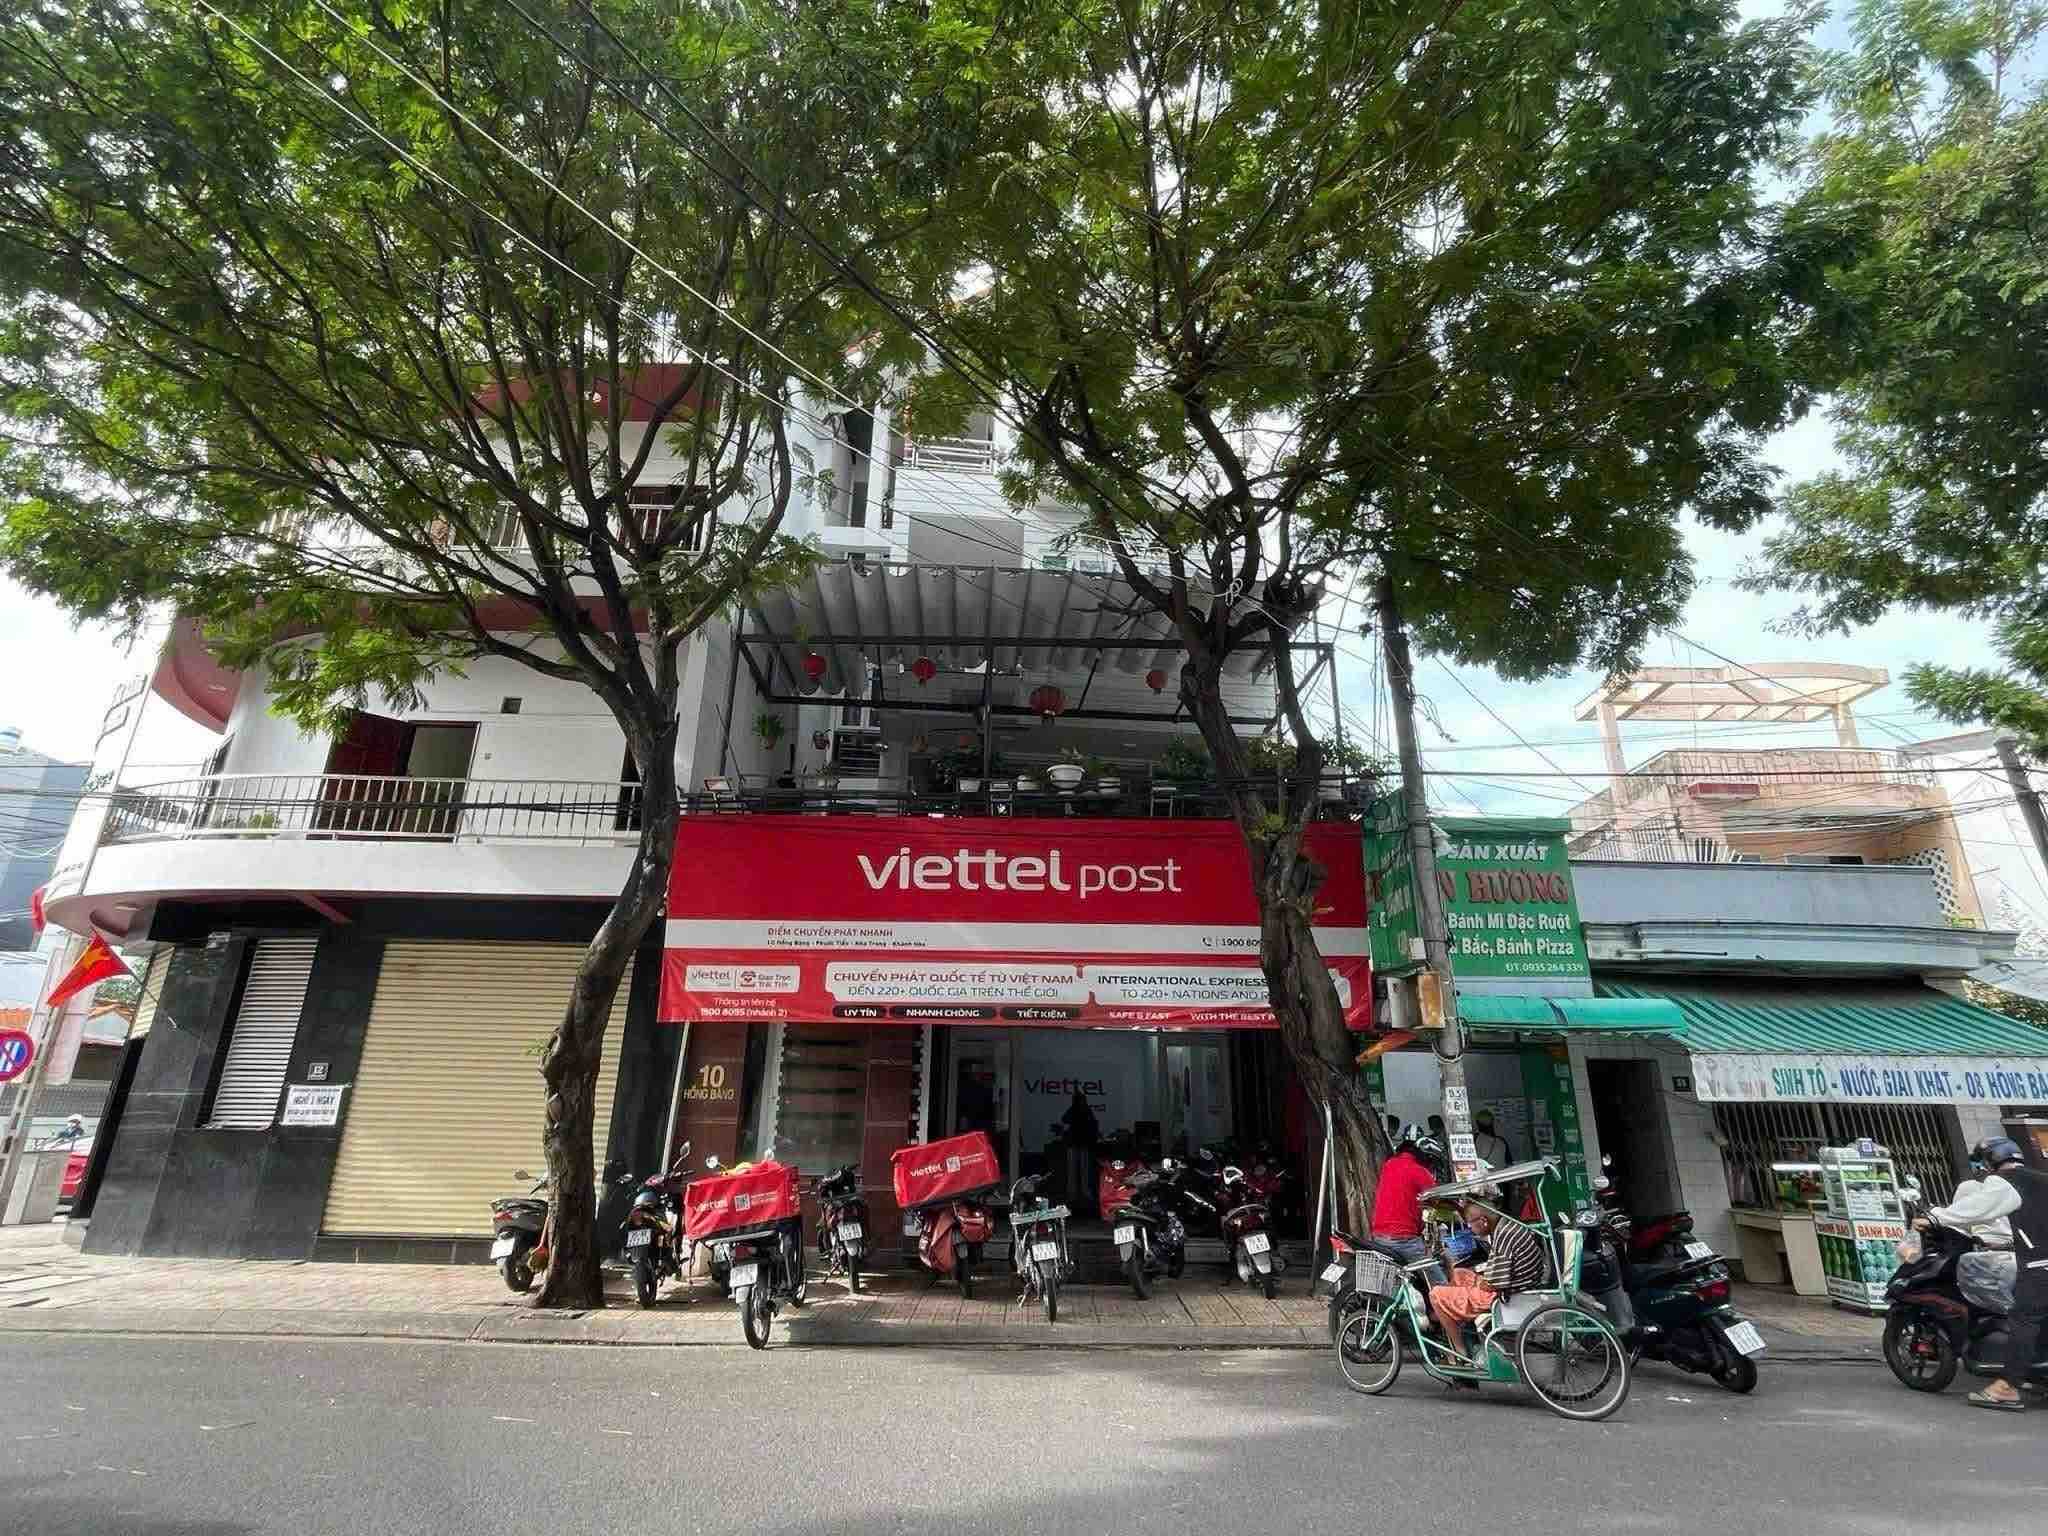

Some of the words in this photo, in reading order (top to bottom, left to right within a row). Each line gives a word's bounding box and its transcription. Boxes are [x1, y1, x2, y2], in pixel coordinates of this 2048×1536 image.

[857, 847, 1072, 891] viettel
[1079, 859, 1182, 899] post
[1448, 912, 1484, 929] Bánh
[859, 928, 894, 937] NHANH
[1496, 936, 1533, 955] Bánh
[1536, 938, 1575, 956] Pizza
[891, 969, 926, 982] PHÁT
[930, 968, 967, 983] QUỐC
[1041, 975, 1073, 984] NAM
[1098, 975, 1206, 986] INTERNATIONAL
[1120, 988, 1138, 998] TO
[1171, 990, 1229, 1000] NATIONS
[1231, 990, 1258, 1000] AND
[844, 1008, 859, 1017] UY
[906, 1008, 943, 1017] NHANH
[698, 1064, 725, 1088] 10
[1771, 1067, 1805, 1096] SINH
[910, 1163, 944, 1177] viettel
[1884, 1226, 1904, 1239] BAO
